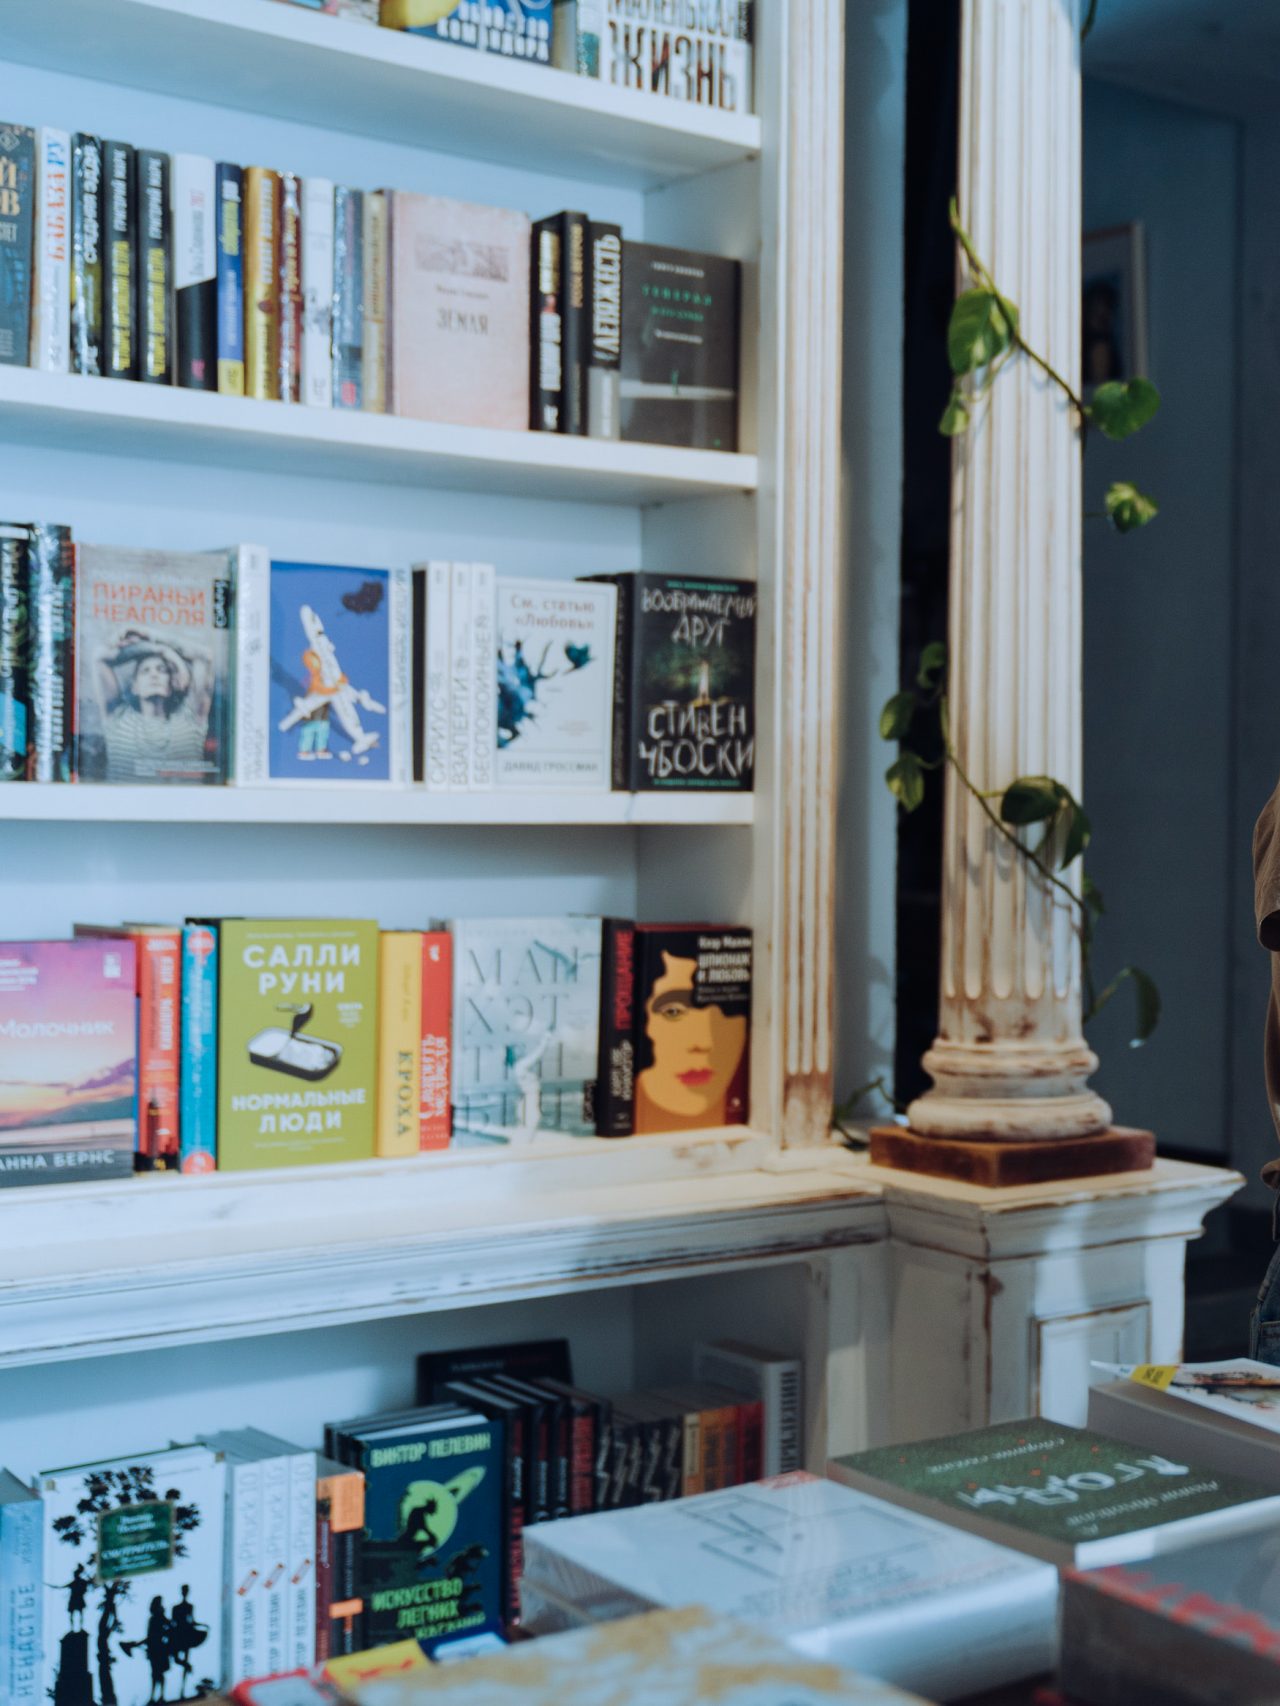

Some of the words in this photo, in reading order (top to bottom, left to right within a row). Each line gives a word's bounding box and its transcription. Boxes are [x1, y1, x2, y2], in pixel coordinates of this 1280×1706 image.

[608, 20, 736, 111] ЖИЗНЬ
[93, 581, 206, 607] ПИРАНЬИ
[93, 603, 205, 626] НЕАПОЛЯ
[672, 615, 731, 648] ДРУГ
[452, 675, 469, 785] ВЗАПЕРТИ
[648, 700, 747, 741] СТИВЕН
[430, 698, 448, 785] СИРИУС
[638, 737, 754, 778] ЧБОСКИ
[242, 944, 361, 969] САЛЛИ
[258, 971, 345, 995] РУНИ
[0, 1019, 114, 1040] Молочник
[231, 1088, 367, 1112] НОРМАЛЬНЫЕ
[397, 1050, 413, 1136] КРОХА
[258, 1110, 342, 1135] ЛЮДИ
[53, 1149, 115, 1168] БЕРНС
[370, 1442, 427, 1468] ВИКТОР
[428, 1432, 491, 1459] ПЕЛЕВИН
[371, 1577, 463, 1612] ИСКУССТВО
[396, 1599, 460, 1628] ЛЕГКИХ
[18, 1583, 35, 1697] НЕНАСТЬЕ
